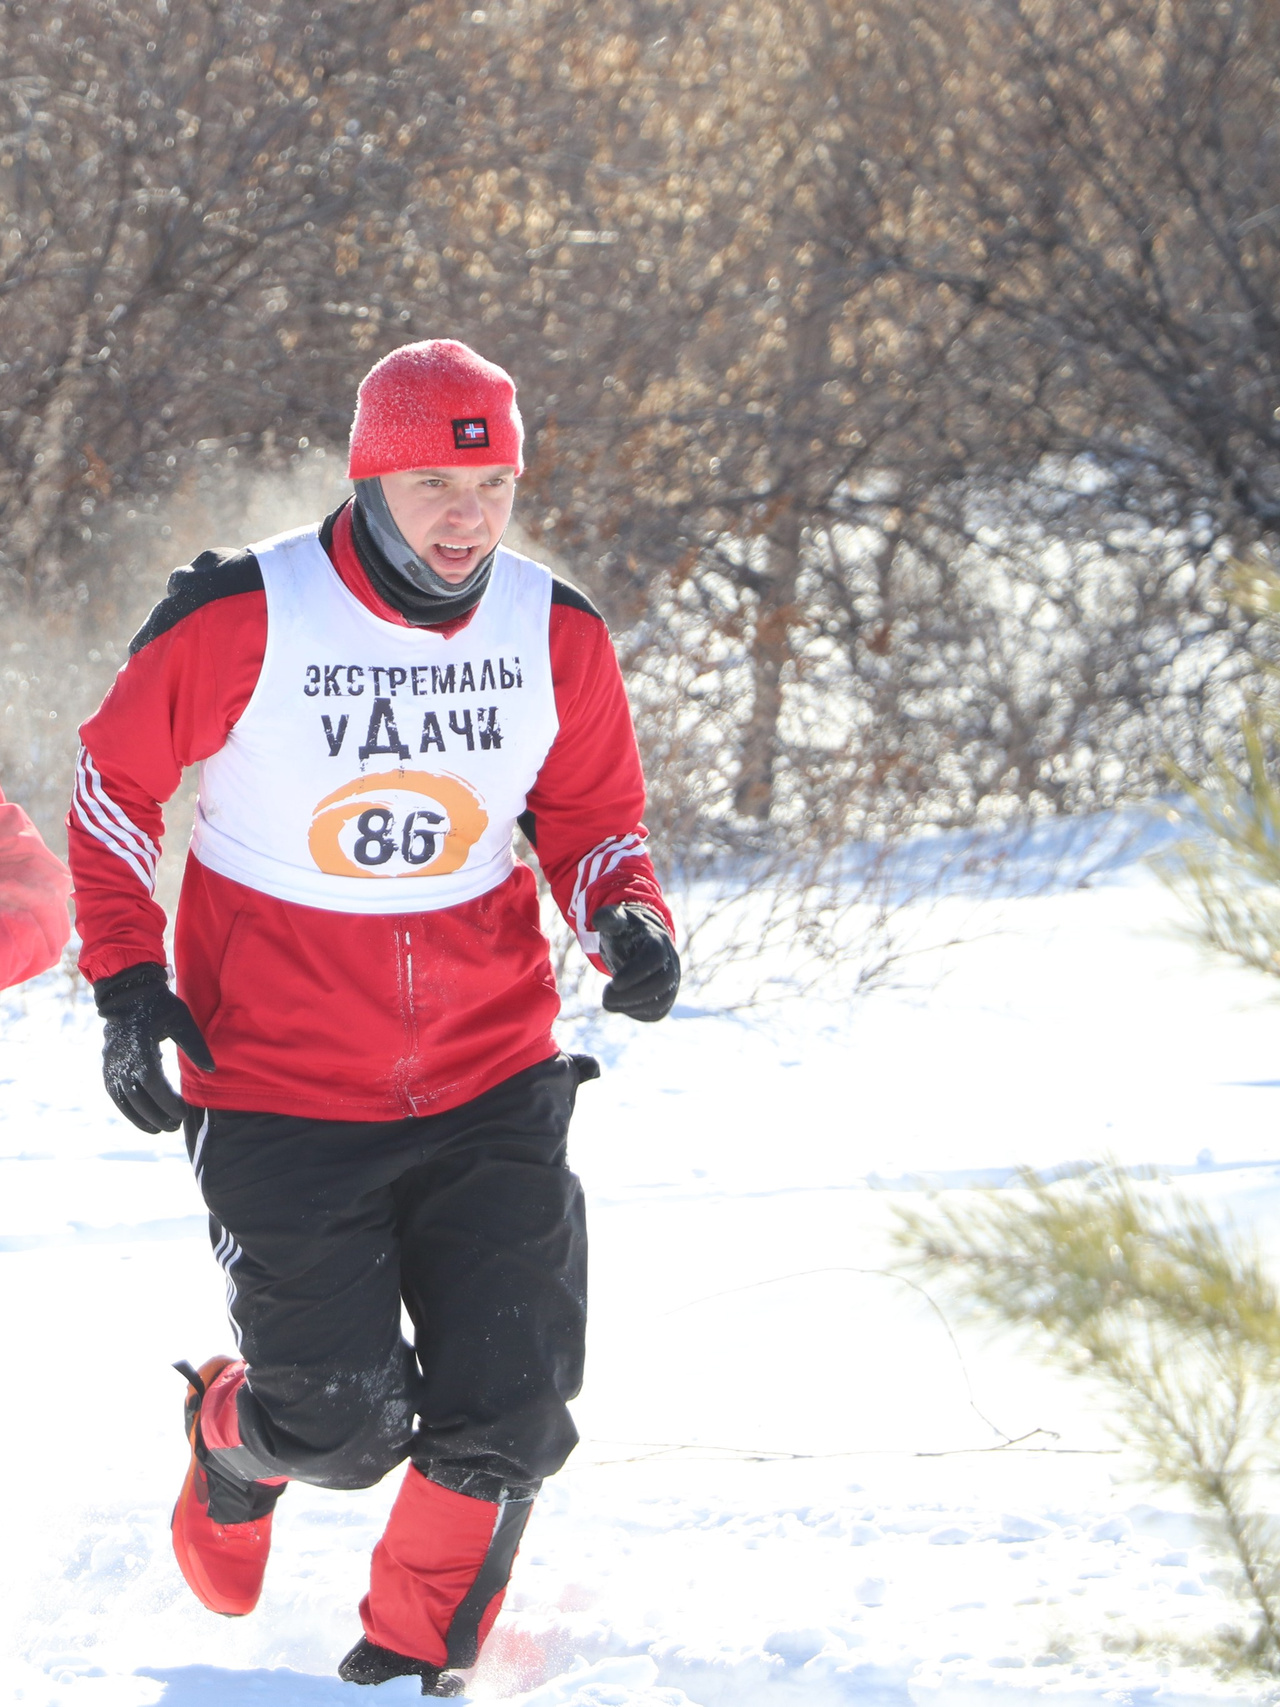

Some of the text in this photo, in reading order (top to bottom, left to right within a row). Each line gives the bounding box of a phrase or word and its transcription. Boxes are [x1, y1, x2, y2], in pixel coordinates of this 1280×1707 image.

[303, 656, 524, 697] ЭКСТРЕМАЛЫ
[320, 697, 504, 760] УДАЧИ
[353, 807, 448, 866] 86
